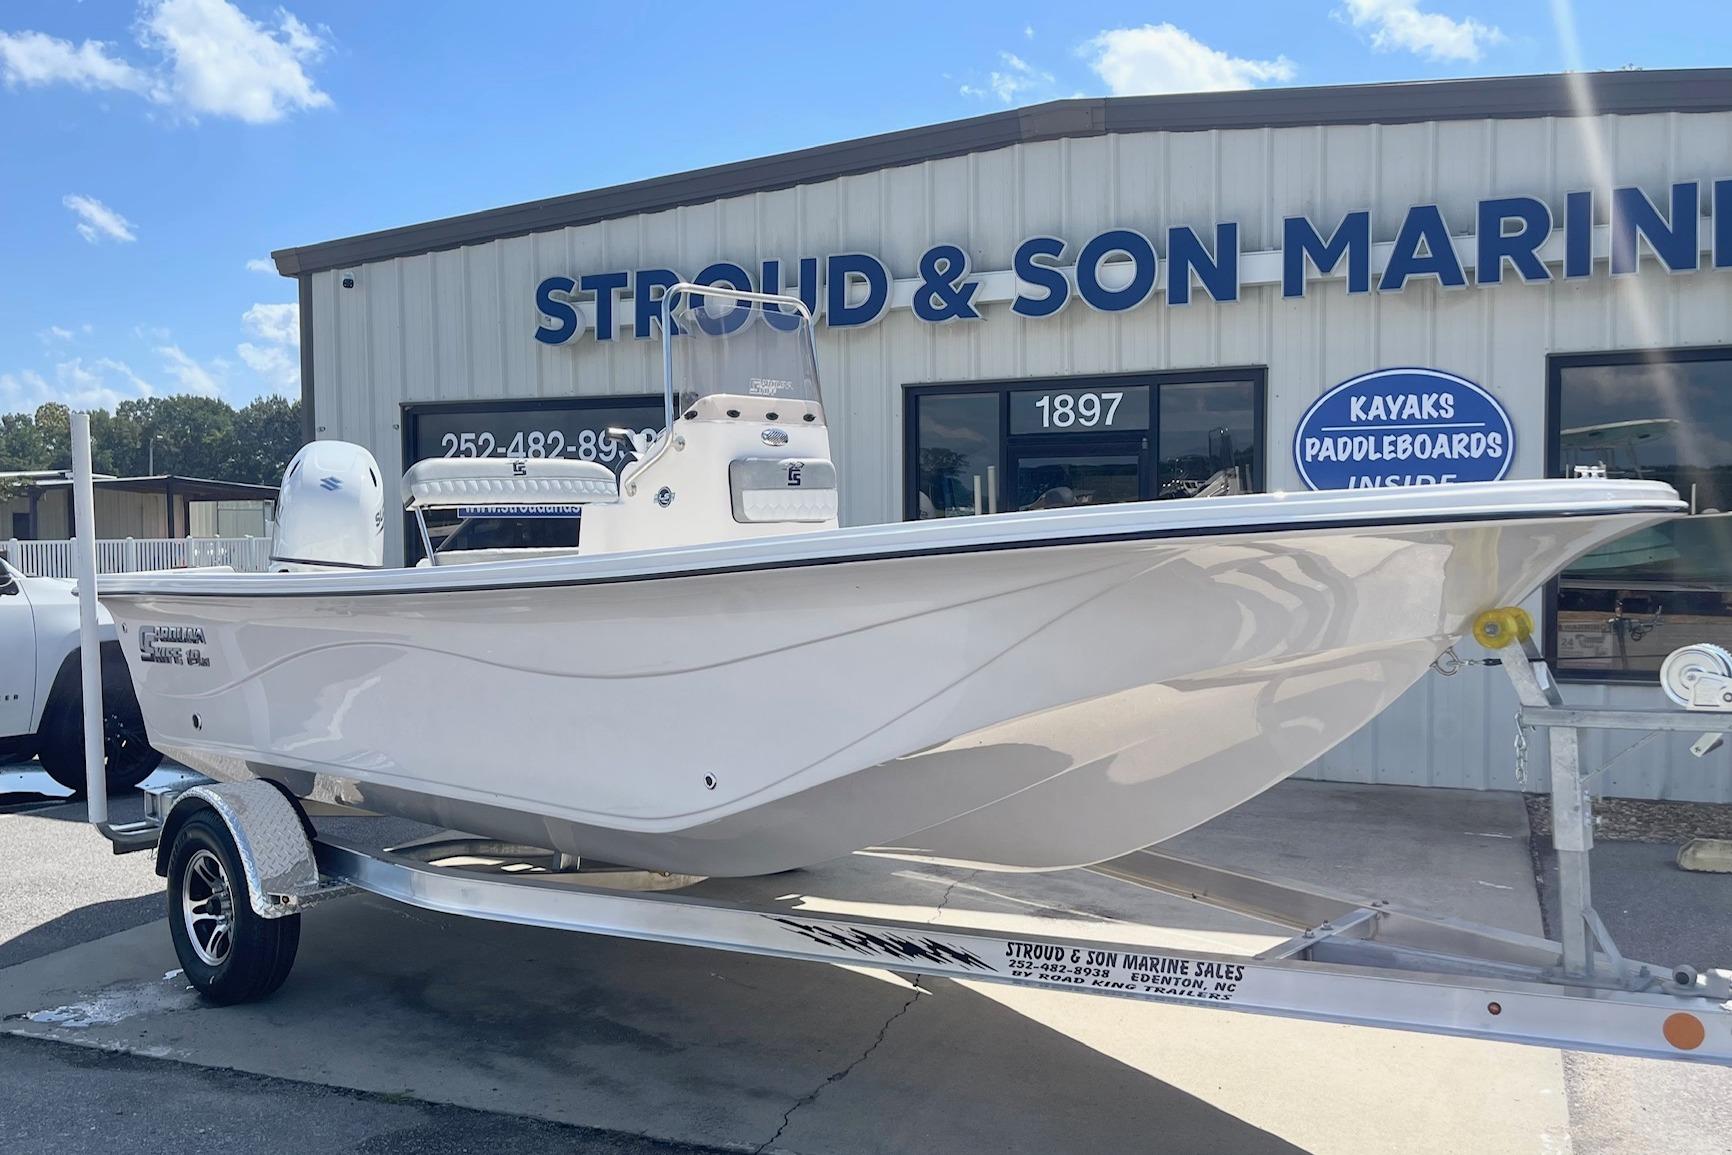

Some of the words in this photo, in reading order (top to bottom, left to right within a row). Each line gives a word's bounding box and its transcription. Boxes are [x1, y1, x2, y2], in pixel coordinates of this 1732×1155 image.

[534, 253, 891, 345] STROUD
[913, 244, 981, 322] &
[1010, 221, 1240, 318] SON
[1035, 392, 1124, 428] 1897
[1350, 392, 1455, 422] KAYAKS
[441, 428, 658, 463] 252-482-89
[1304, 431, 1503, 463] PADDLEBOARDS
[1005, 941, 1065, 962] STROUD
[1070, 948, 1081, 964] &
[1086, 950, 1118, 968] SON
[1122, 954, 1190, 976] MARINE
[1194, 961, 1245, 982] SALES
[1008, 959, 1110, 979] 252-482-8938
[1130, 972, 1208, 991] EDENTON,
[1214, 982, 1237, 993] NC
[1011, 970, 1033, 978] BY
[1039, 973, 1085, 984] ROAD
[1092, 979, 1137, 990] KING
[1144, 985, 1233, 1001] TRAILERS
